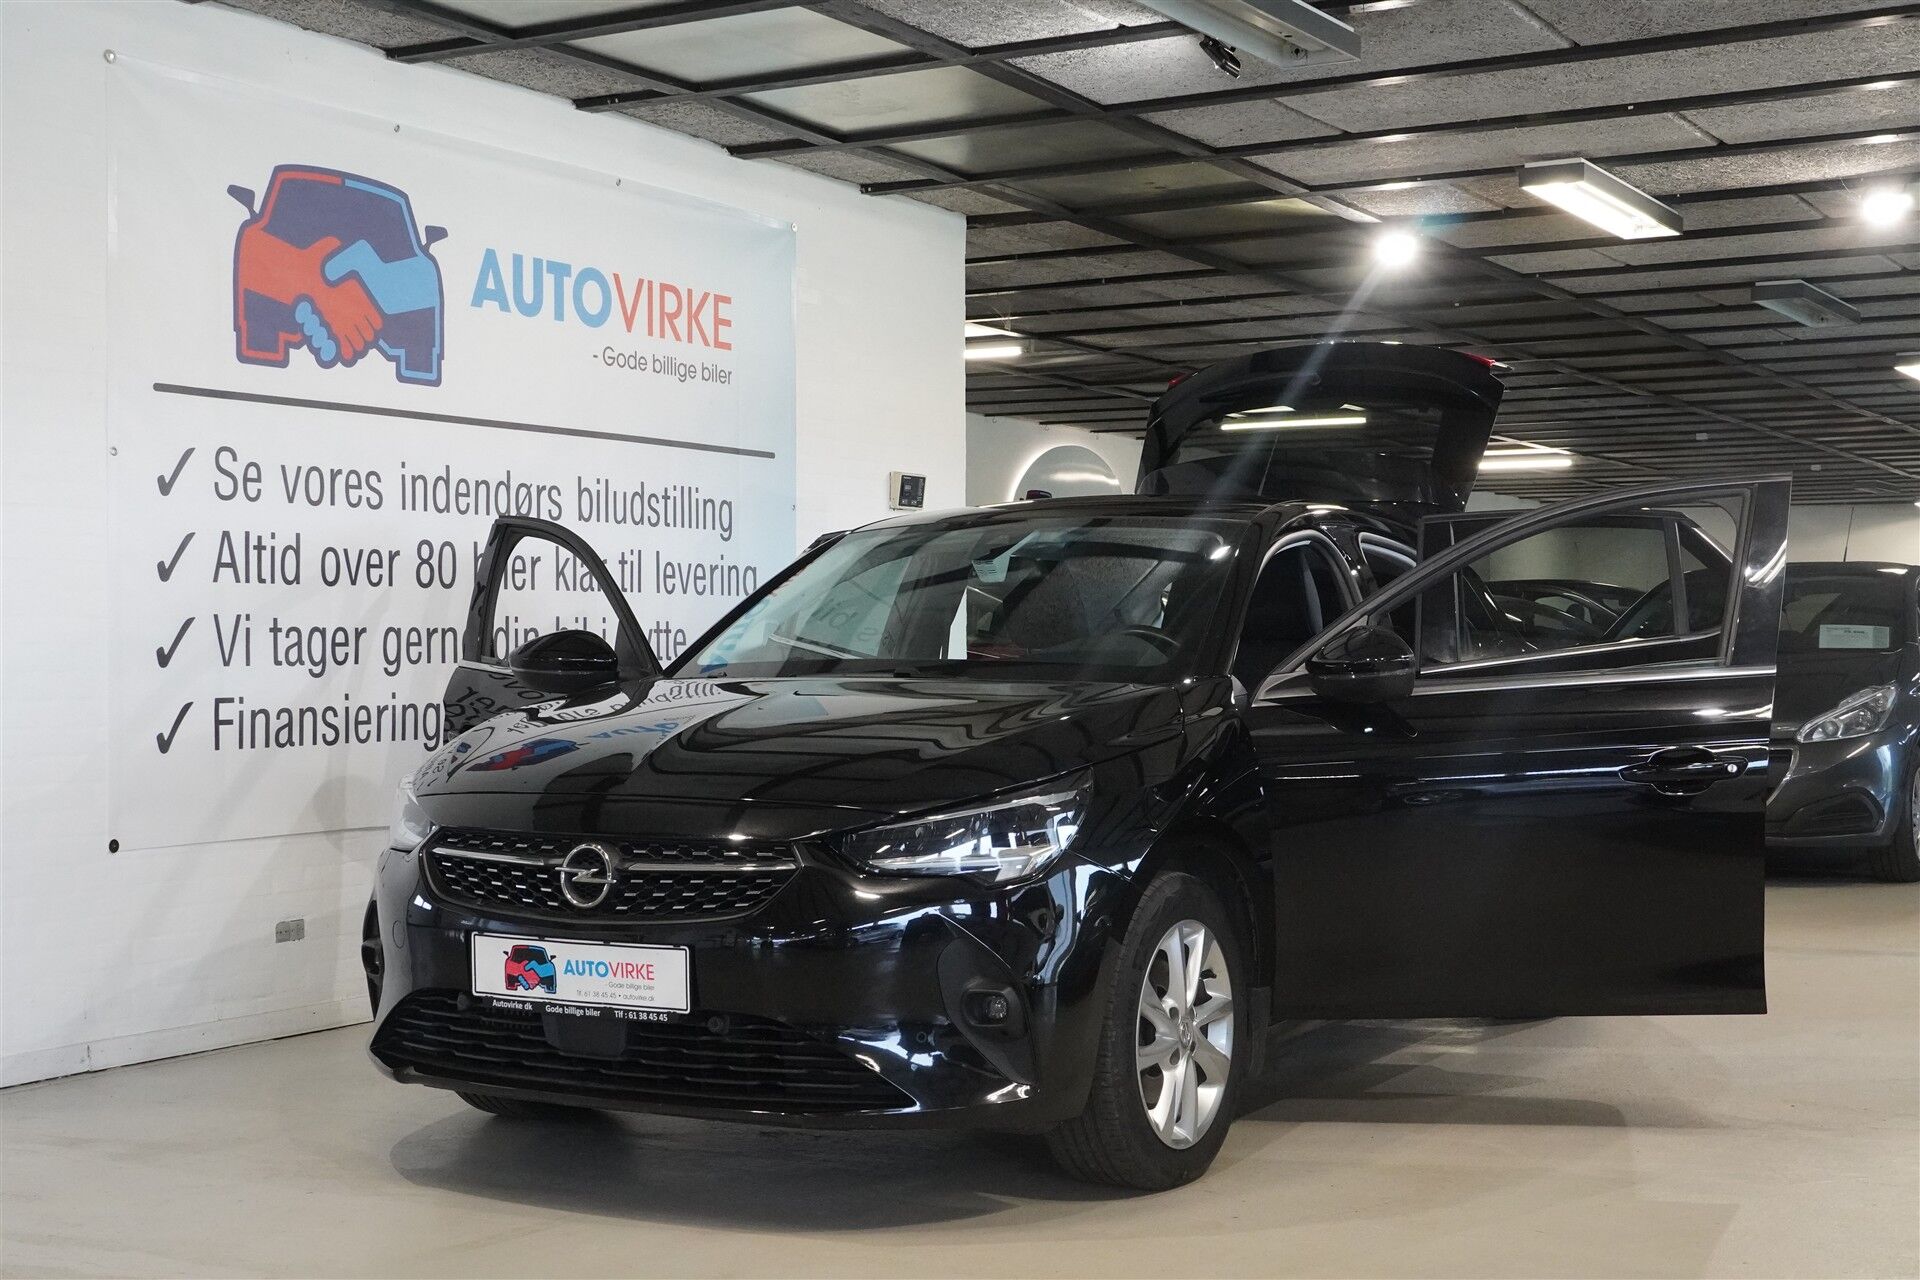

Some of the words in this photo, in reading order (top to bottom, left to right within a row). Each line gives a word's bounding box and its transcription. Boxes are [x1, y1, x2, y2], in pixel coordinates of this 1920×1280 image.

[470, 247, 733, 352] AUTOVIRKE
[602, 346, 648, 372] Gode
[651, 353, 698, 384] billige
[701, 361, 733, 386] biler
[213, 445, 262, 503] Se
[280, 464, 384, 511] vores
[400, 461, 563, 522] indendørs
[577, 475, 733, 543] biludstilling
[212, 530, 301, 586] Altid
[320, 546, 401, 588] over
[415, 538, 457, 590] 80
[618, 549, 642, 594] til
[213, 613, 251, 667] Vi
[268, 617, 368, 679] tager
[382, 626, 458, 678] gern
[213, 691, 448, 753] Finansiering
[563, 959, 655, 981] AUTOVIRKE
[545, 1005, 563, 1014] Gode
[564, 1006, 584, 1017] billige
[585, 1008, 601, 1017] biler
[628, 1011, 637, 1019] 61
[638, 1012, 647, 1020] 38
[648, 1013, 658, 1021] 45
[658, 1013, 668, 1022] 45
